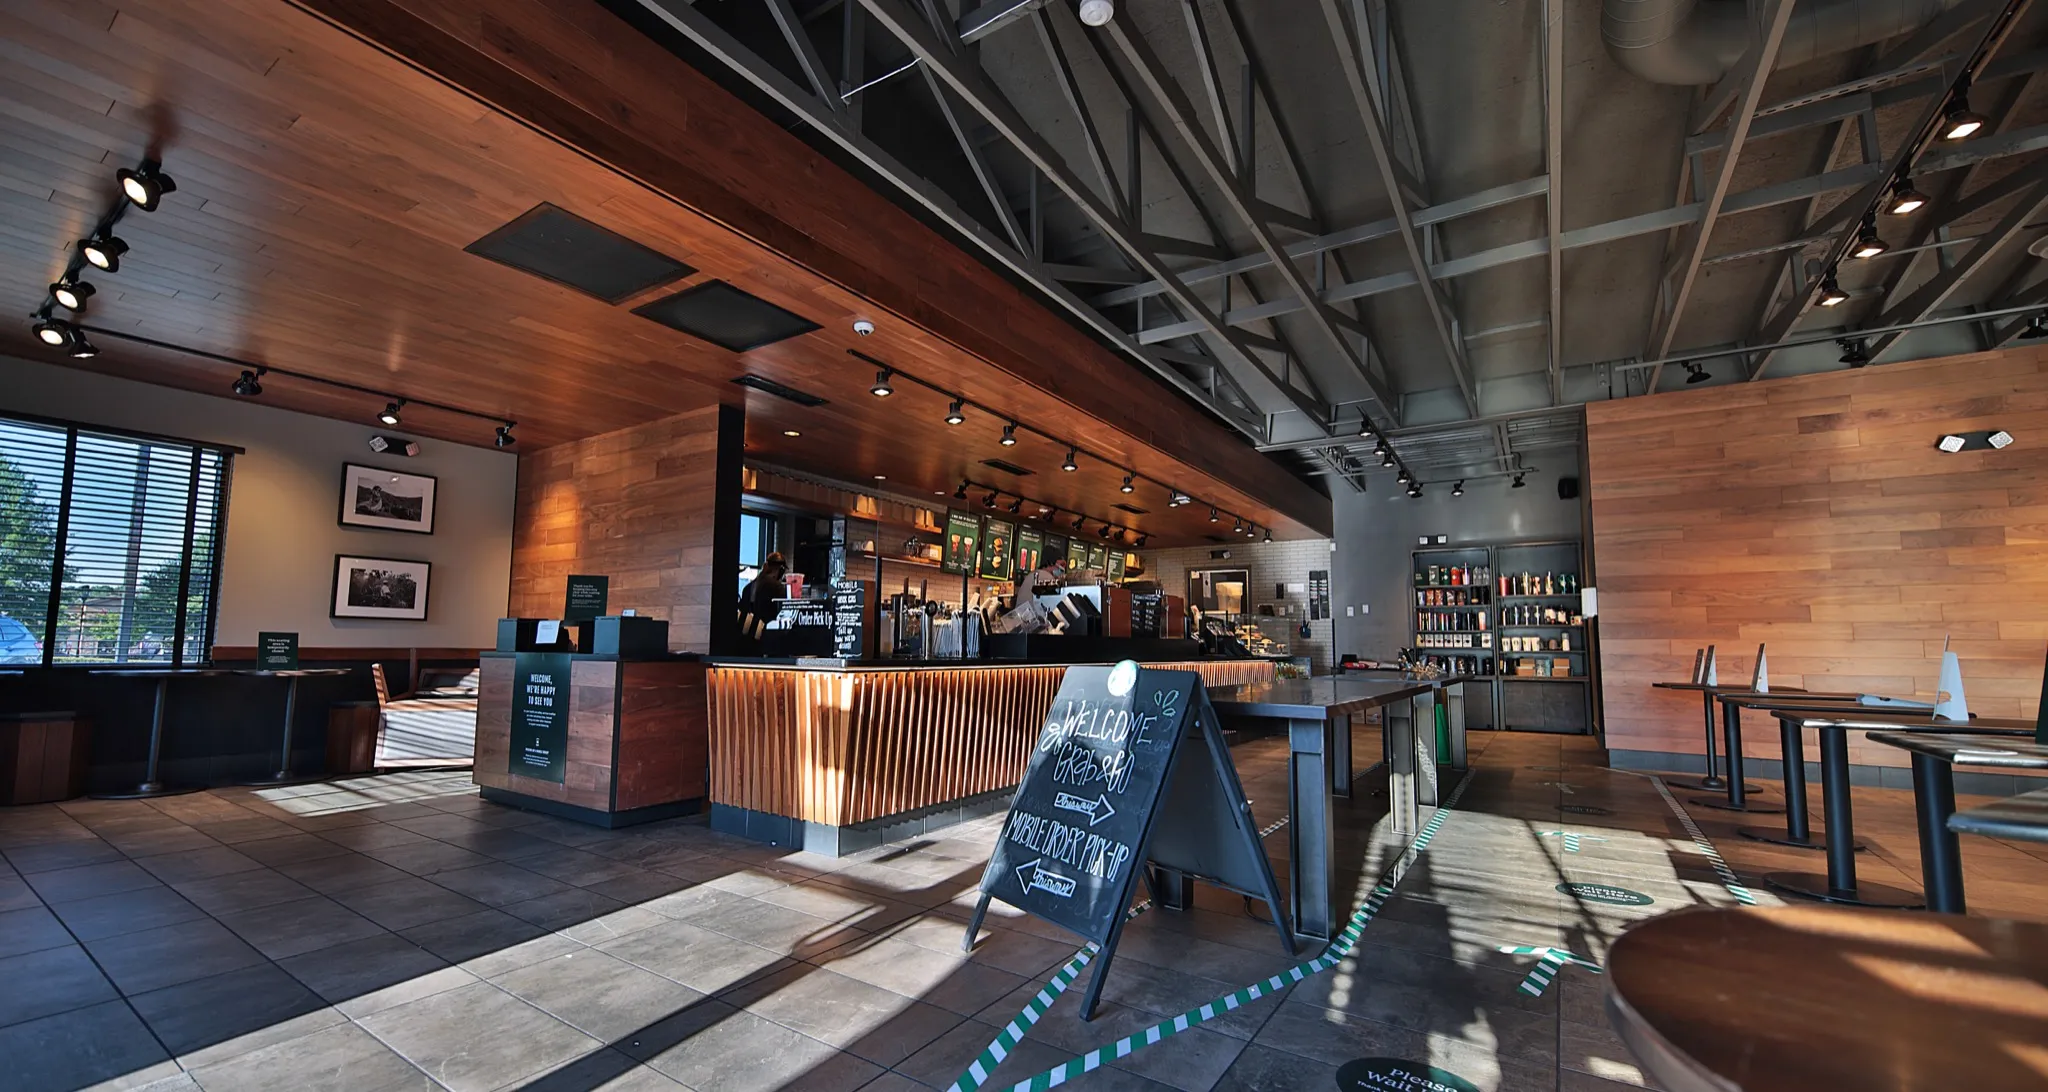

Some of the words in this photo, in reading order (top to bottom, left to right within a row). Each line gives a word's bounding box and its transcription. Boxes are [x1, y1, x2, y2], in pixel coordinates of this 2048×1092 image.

[798, 611, 813, 626] Order
[813, 611, 825, 626] Pick
[825, 611, 833, 630] Up
[530, 673, 553, 685] WELCOME,
[526, 684, 540, 695] WE'RE
[540, 685, 556, 696] HAPPY
[528, 695, 534, 705] TO
[534, 696, 543, 706] SEE
[543, 697, 553, 707] YOU
[1061, 700, 1157, 748] WELCOME
[1005, 809, 1049, 853] MOBILE
[1041, 820, 1085, 865] ORDER
[1077, 833, 1130, 883] PICK-UP
[1583, 885, 1624, 895] Please
[1367, 1070, 1414, 1092] Wait
